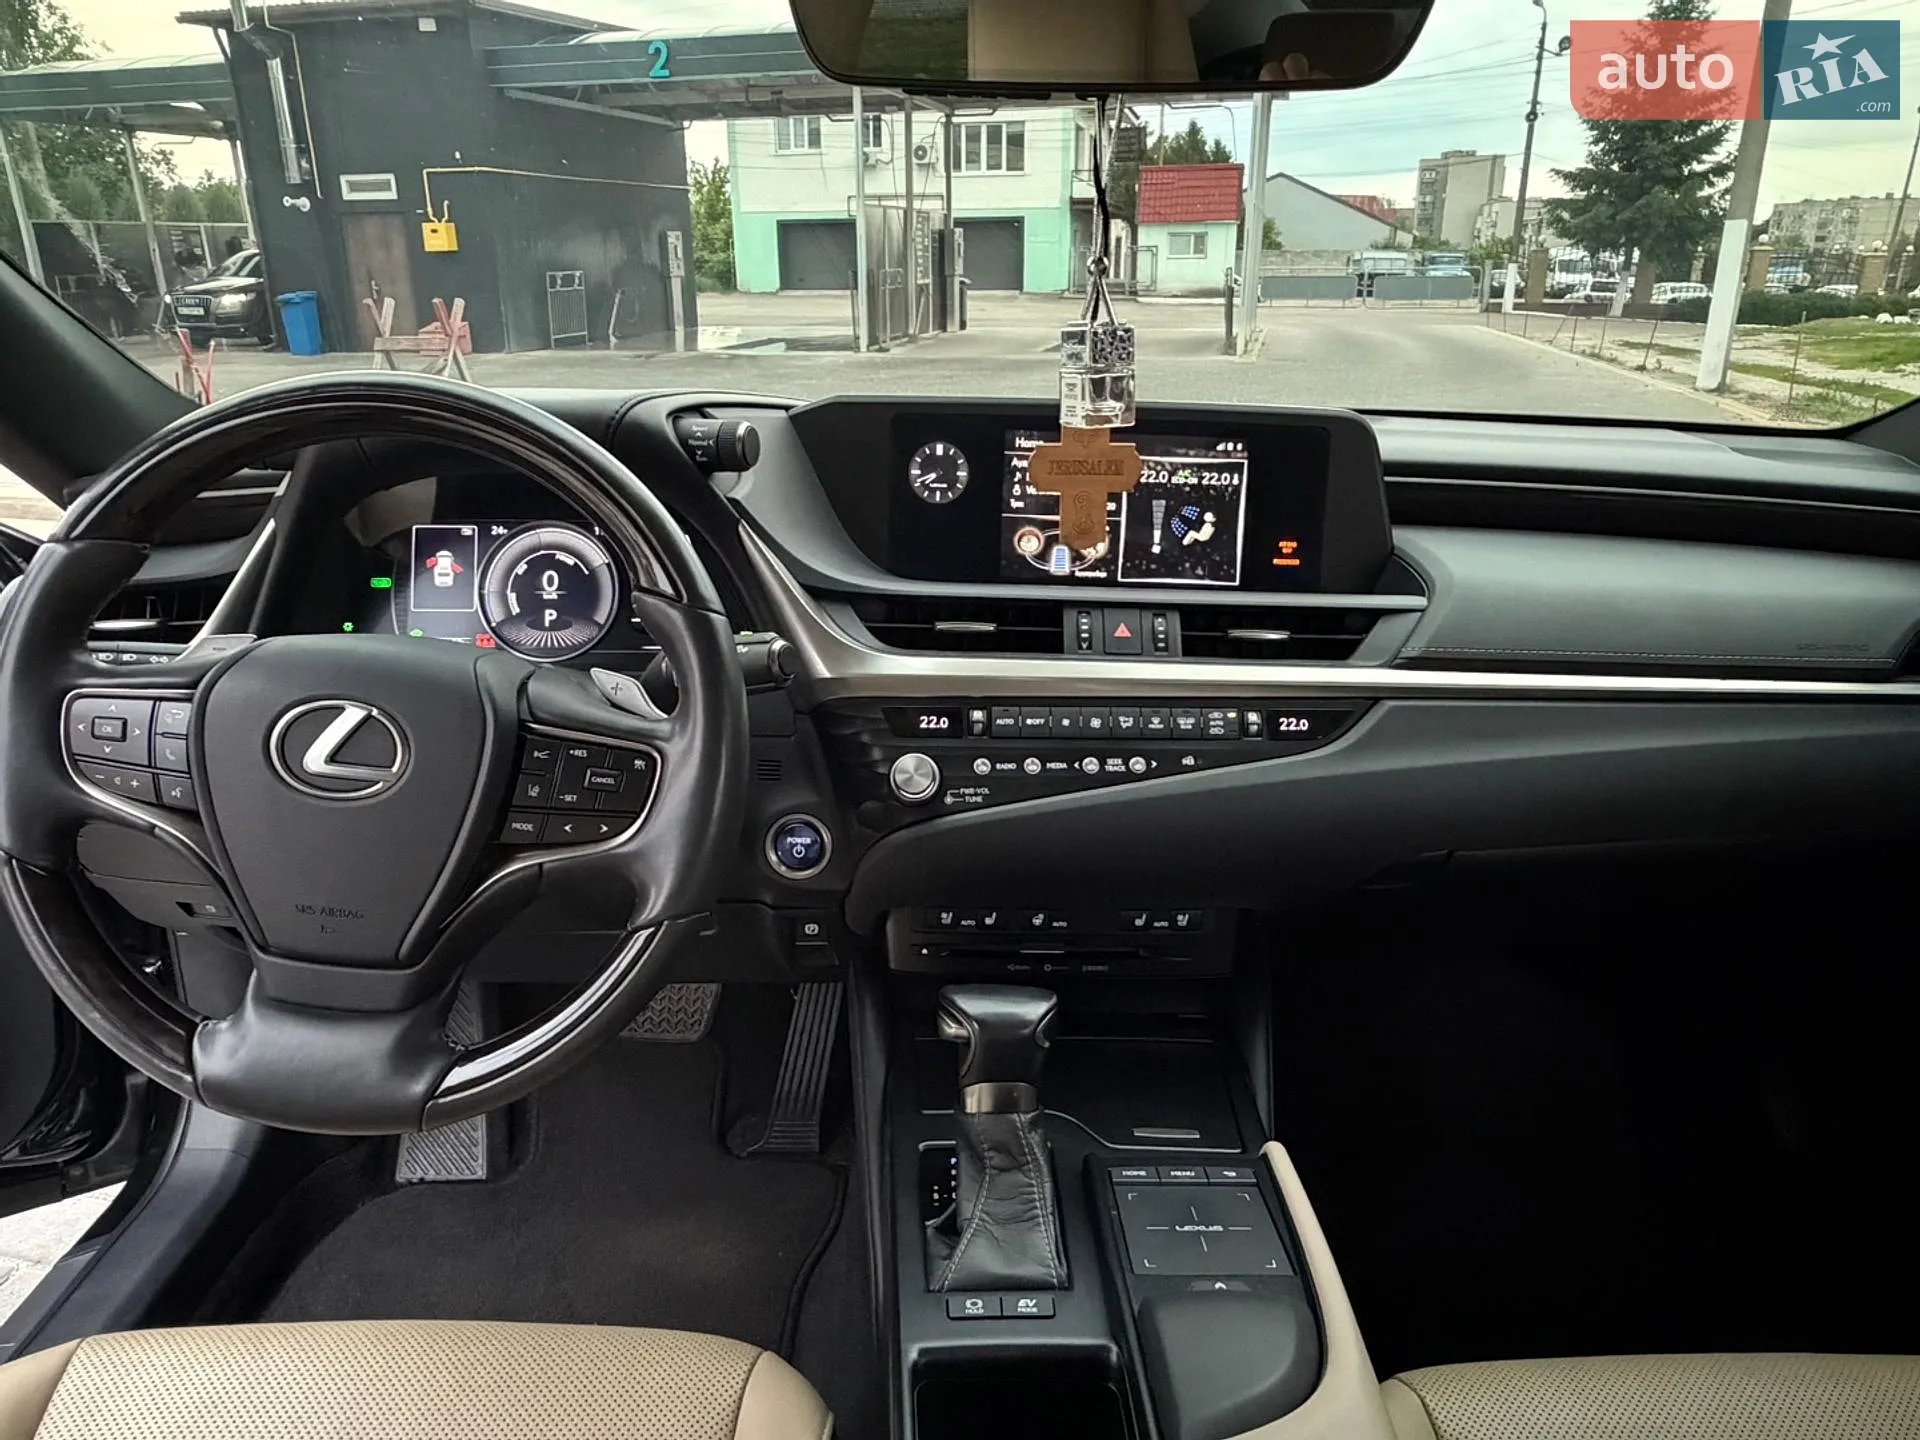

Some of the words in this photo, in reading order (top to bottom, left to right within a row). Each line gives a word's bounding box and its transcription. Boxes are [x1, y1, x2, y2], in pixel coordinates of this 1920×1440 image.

[648, 40, 670, 78] 2
[1048, 460, 1125, 476] JERUSALEM
[1140, 470, 1169, 483] 22.0
[1201, 472, 1230, 485] 22.0
[542, 570, 559, 592] 0
[544, 608, 557, 627] P
[919, 715, 949, 729] 22.0
[1279, 717, 1309, 731] 22.0
[996, 762, 1017, 770] RADIO
[590, 776, 616, 785] CANCEL
[511, 822, 535, 831] MODE
[786, 837, 812, 845] POWER
[319, 906, 365, 920] AIRBAG
[1017, 1299, 1037, 1307] EV
